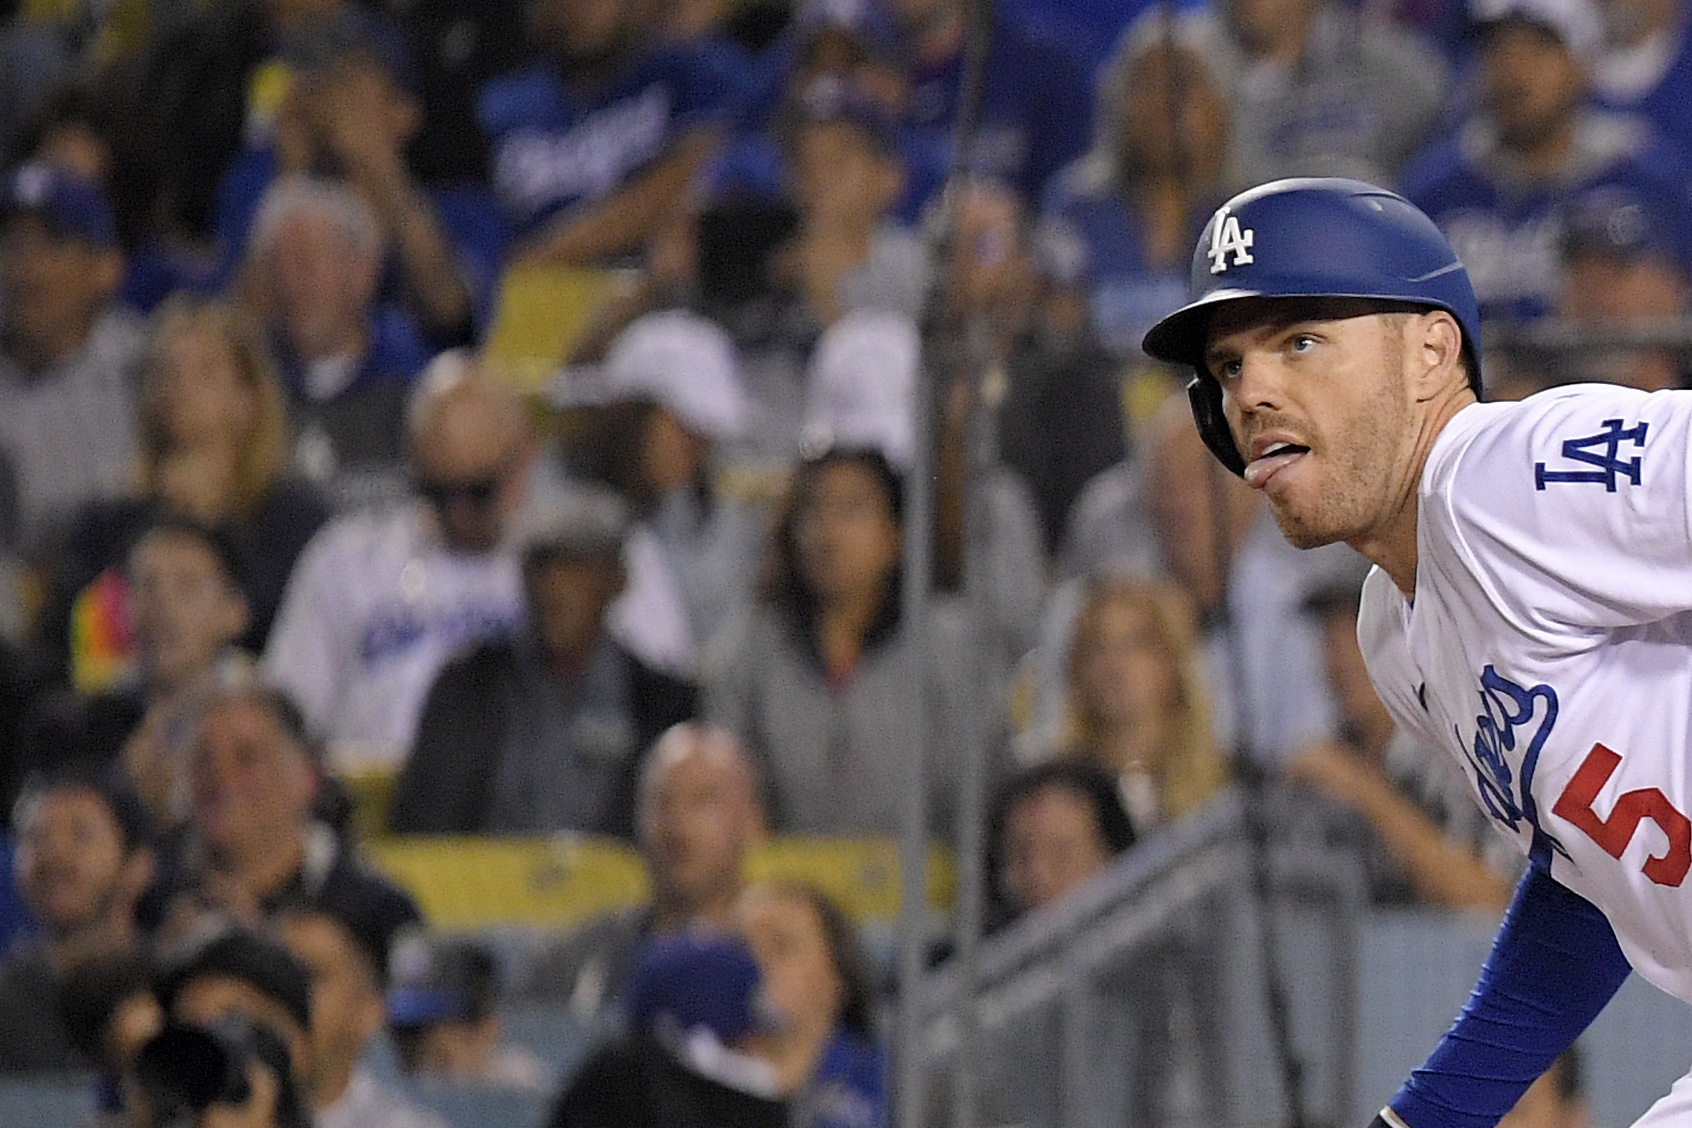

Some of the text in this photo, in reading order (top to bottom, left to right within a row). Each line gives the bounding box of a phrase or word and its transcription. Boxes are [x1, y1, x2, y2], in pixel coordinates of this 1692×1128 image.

[1207, 206, 1254, 274] LA
[1534, 418, 1650, 493] LA
[1551, 741, 1692, 888] 5
